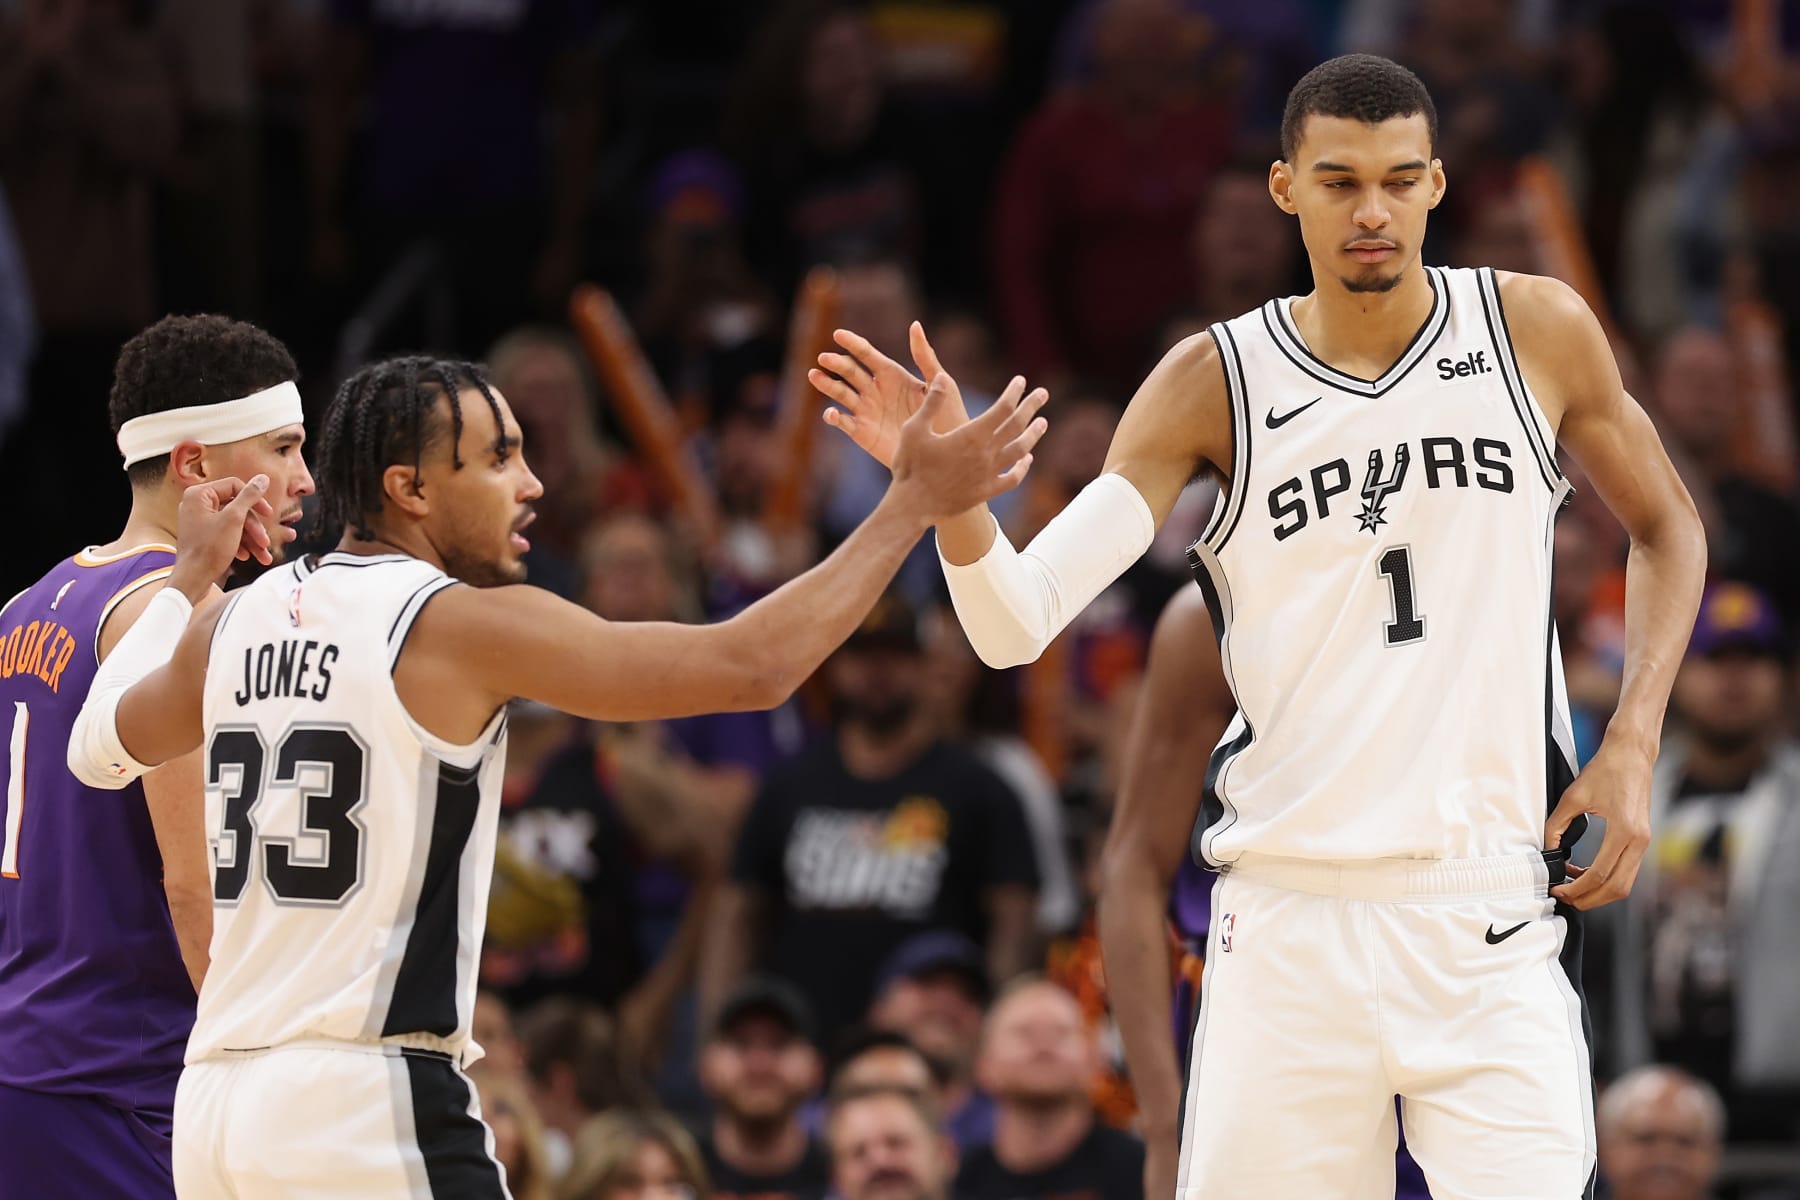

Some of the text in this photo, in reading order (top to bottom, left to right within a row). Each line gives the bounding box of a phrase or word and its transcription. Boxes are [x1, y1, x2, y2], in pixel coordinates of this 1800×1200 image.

[1437, 351, 1492, 380] Self.
[1268, 437, 1514, 541] SPURS
[1375, 543, 1427, 648] 1
[235, 640, 339, 707] JONES
[1, 701, 30, 879] 1
[205, 721, 371, 909] 33
